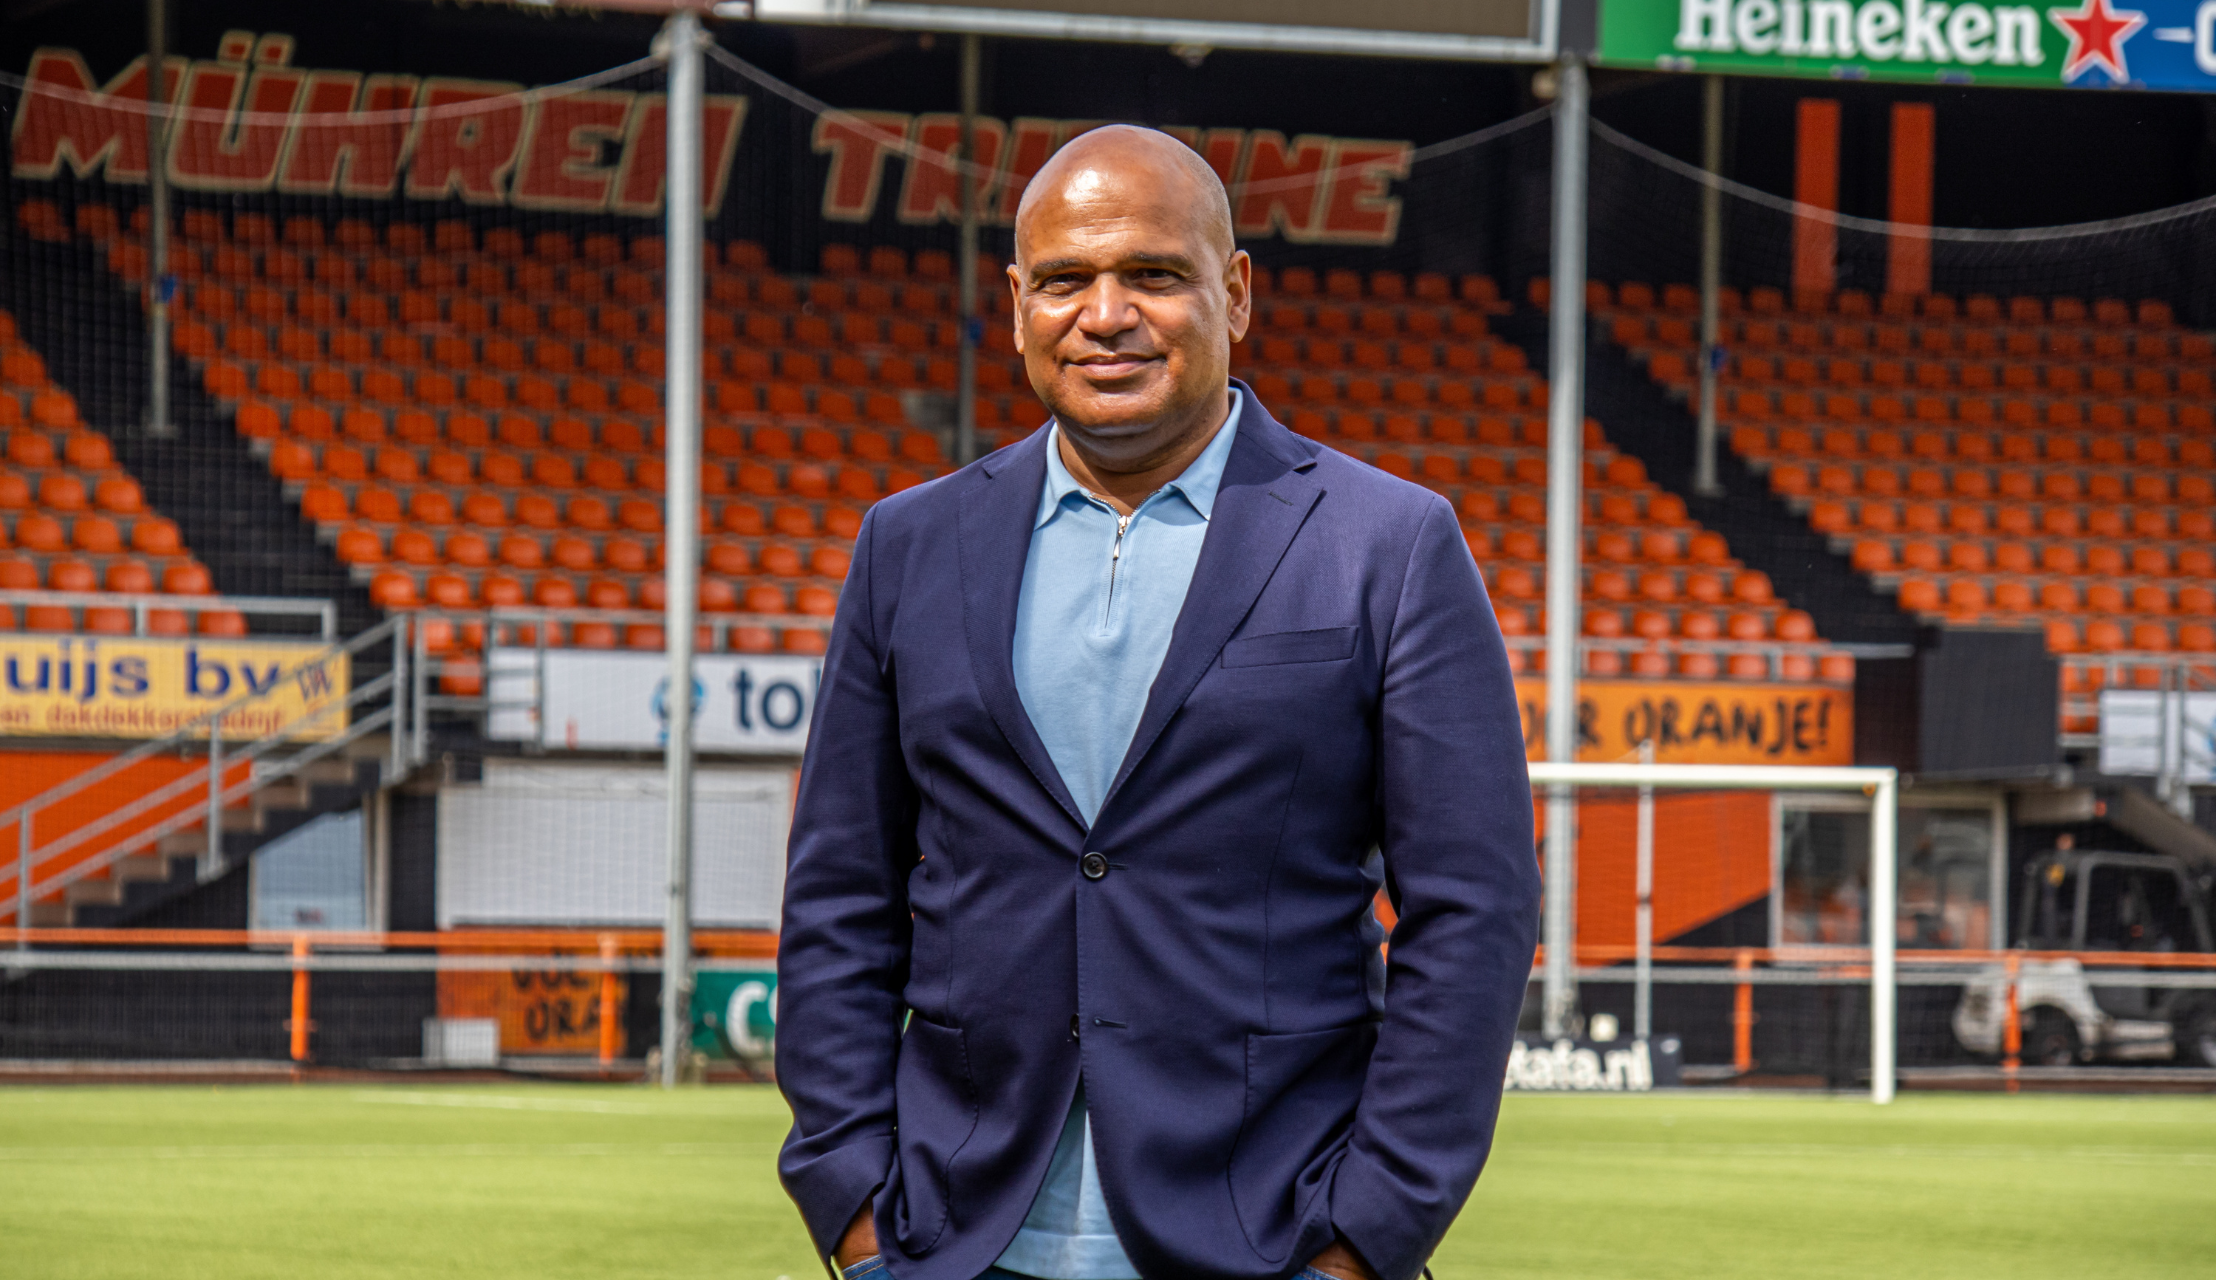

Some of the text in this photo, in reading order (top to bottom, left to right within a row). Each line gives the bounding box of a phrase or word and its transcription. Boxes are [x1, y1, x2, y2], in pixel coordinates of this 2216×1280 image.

[1673, 0, 2046, 67] Heineken
[12, 30, 1414, 245] MÜHREN TRINE
[185, 645, 280, 697] bv
[1624, 697, 1830, 755] ORANJE!
[726, 980, 777, 1057] C
